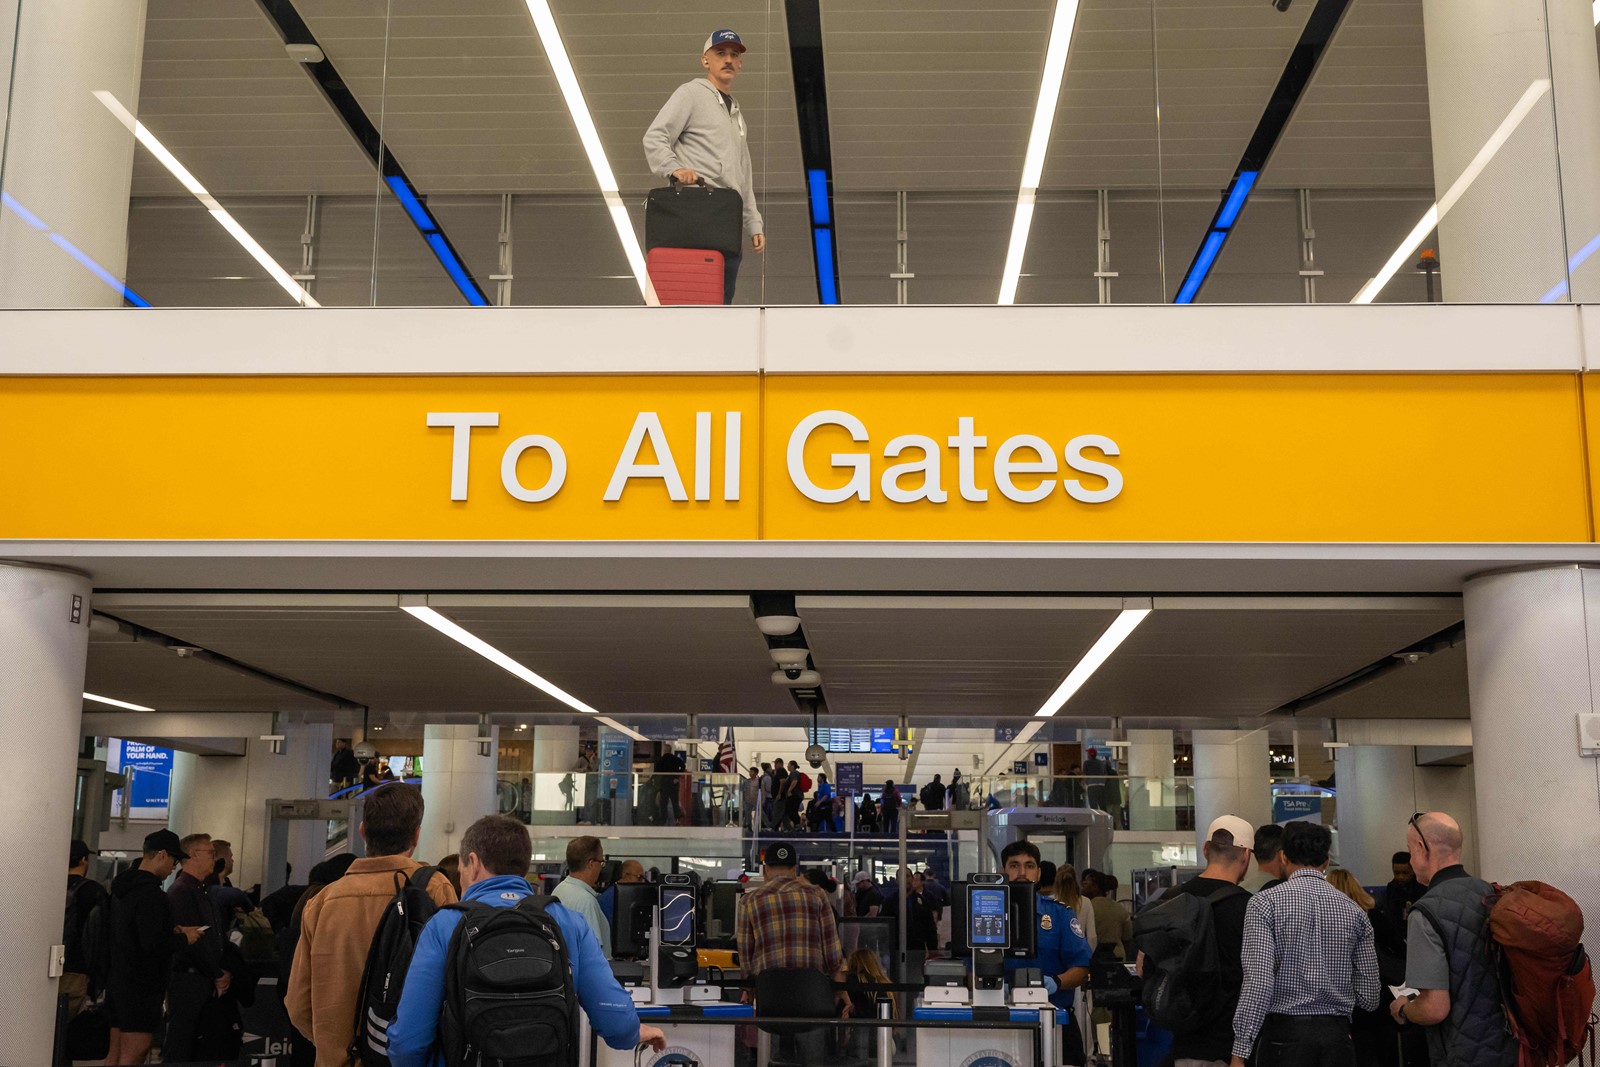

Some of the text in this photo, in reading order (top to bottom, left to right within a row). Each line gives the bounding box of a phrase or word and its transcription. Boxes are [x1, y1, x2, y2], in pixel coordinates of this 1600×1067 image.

[426, 409, 1124, 504] To All Gates
